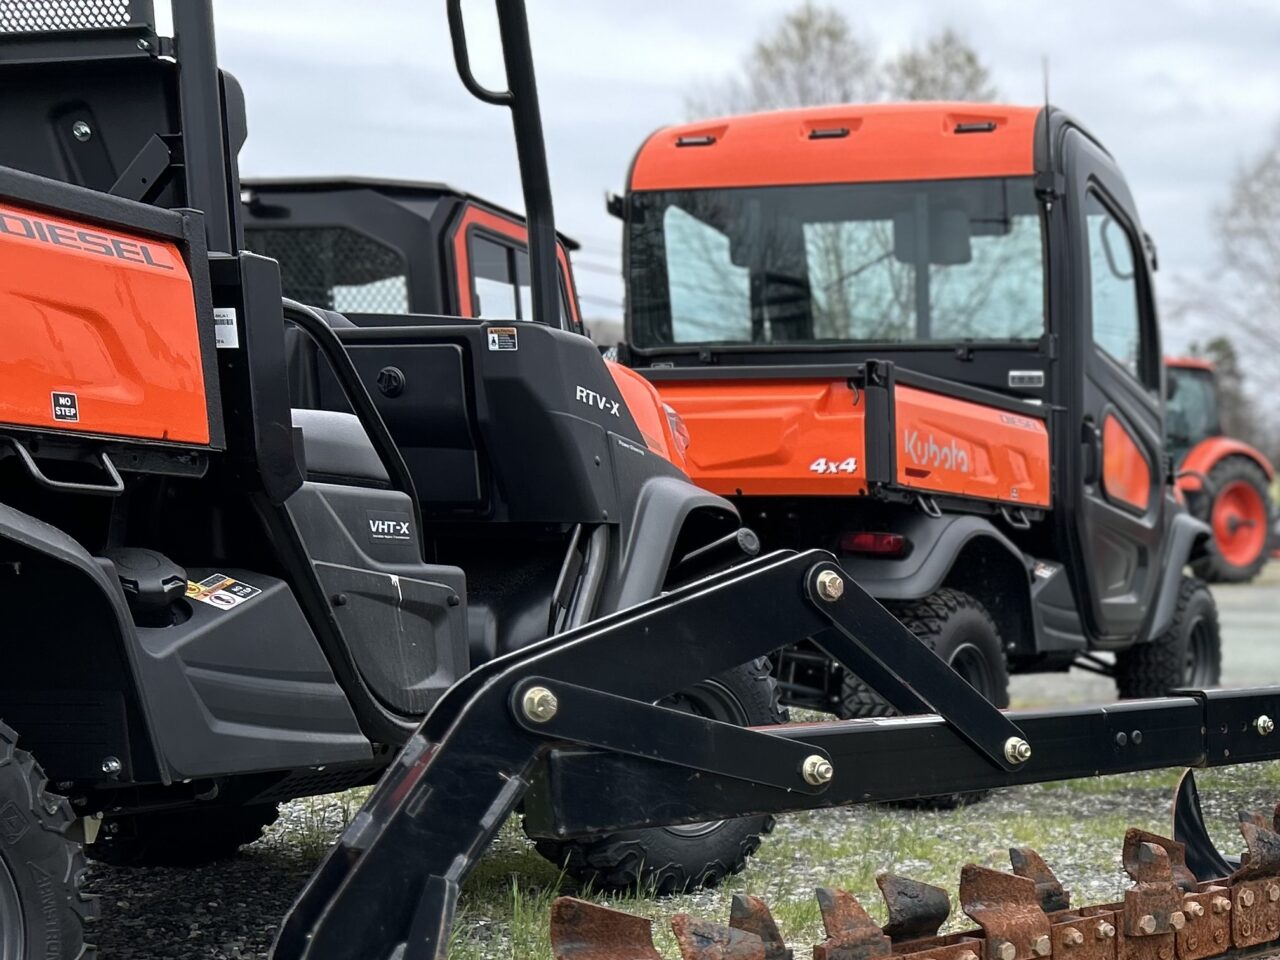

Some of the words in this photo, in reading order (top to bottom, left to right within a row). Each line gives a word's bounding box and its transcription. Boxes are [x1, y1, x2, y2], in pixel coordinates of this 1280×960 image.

[0, 213, 174, 271] DIESEL
[59, 396, 72, 406] NO
[576, 385, 620, 417] RTV-X
[55, 406, 77, 416] STEP
[904, 429, 970, 473] Kubota
[809, 457, 858, 475] 4x4
[369, 519, 410, 534] VHT-X
